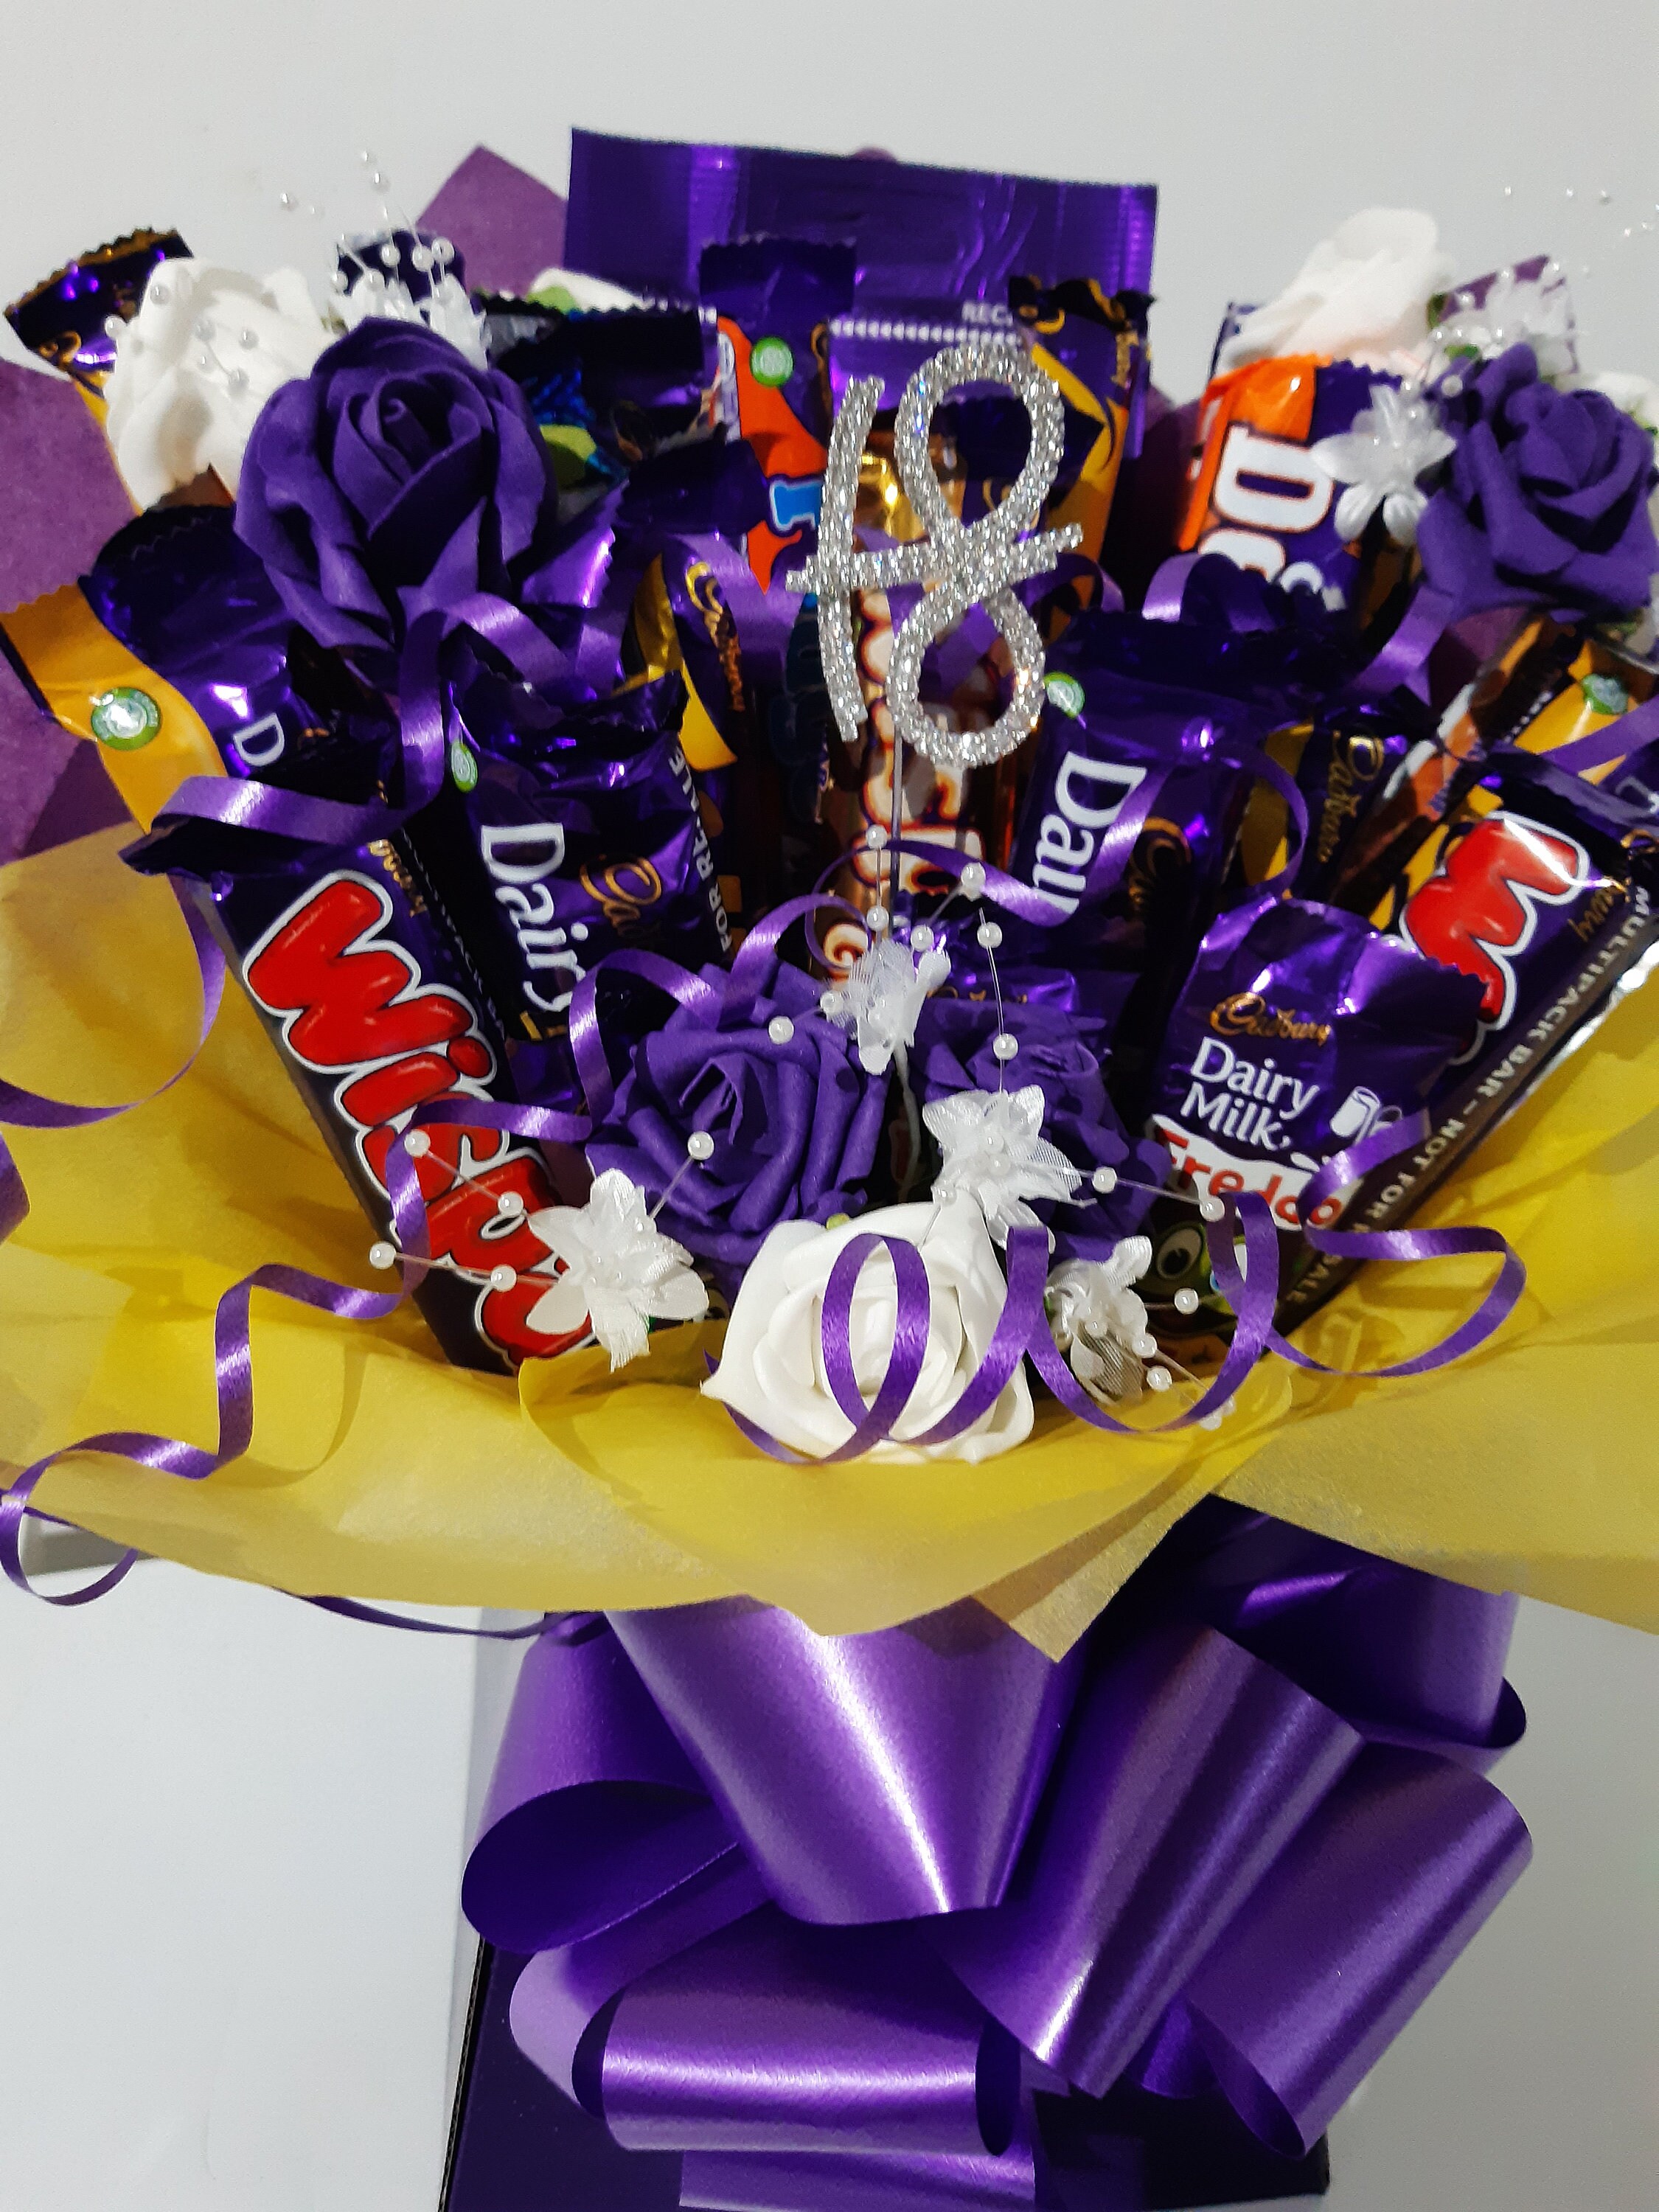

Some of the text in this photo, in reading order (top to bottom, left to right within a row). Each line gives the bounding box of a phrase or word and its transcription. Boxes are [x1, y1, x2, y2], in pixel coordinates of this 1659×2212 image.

[815, 342, 1065, 768] 18
[708, 882, 733, 953] FOR
[1528, 886, 1652, 1042] MULTIPACK
[1209, 992, 1332, 1046] Cadbury
[1190, 1036, 1320, 1119] Dairy
[1477, 1043, 1534, 1097] BAR
[1412, 1118, 1466, 1171] NOT
[1366, 1171, 1416, 1219] FOR
